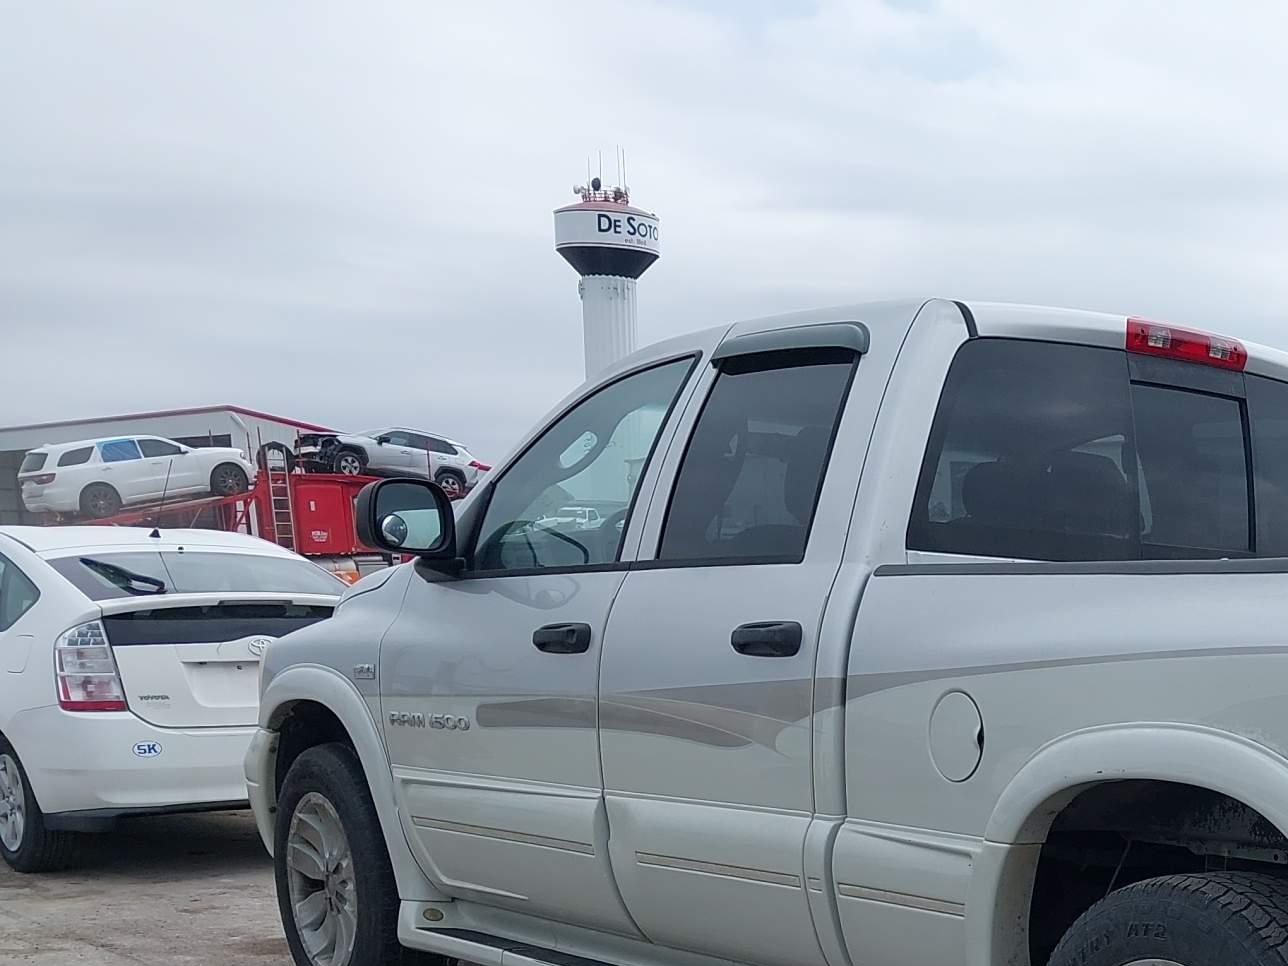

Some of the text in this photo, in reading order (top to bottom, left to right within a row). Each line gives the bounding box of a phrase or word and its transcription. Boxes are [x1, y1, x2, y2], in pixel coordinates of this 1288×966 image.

[389, 711, 470, 731] RAM 1500
[136, 743, 158, 755] SK
[1126, 920, 1169, 941] AT2
